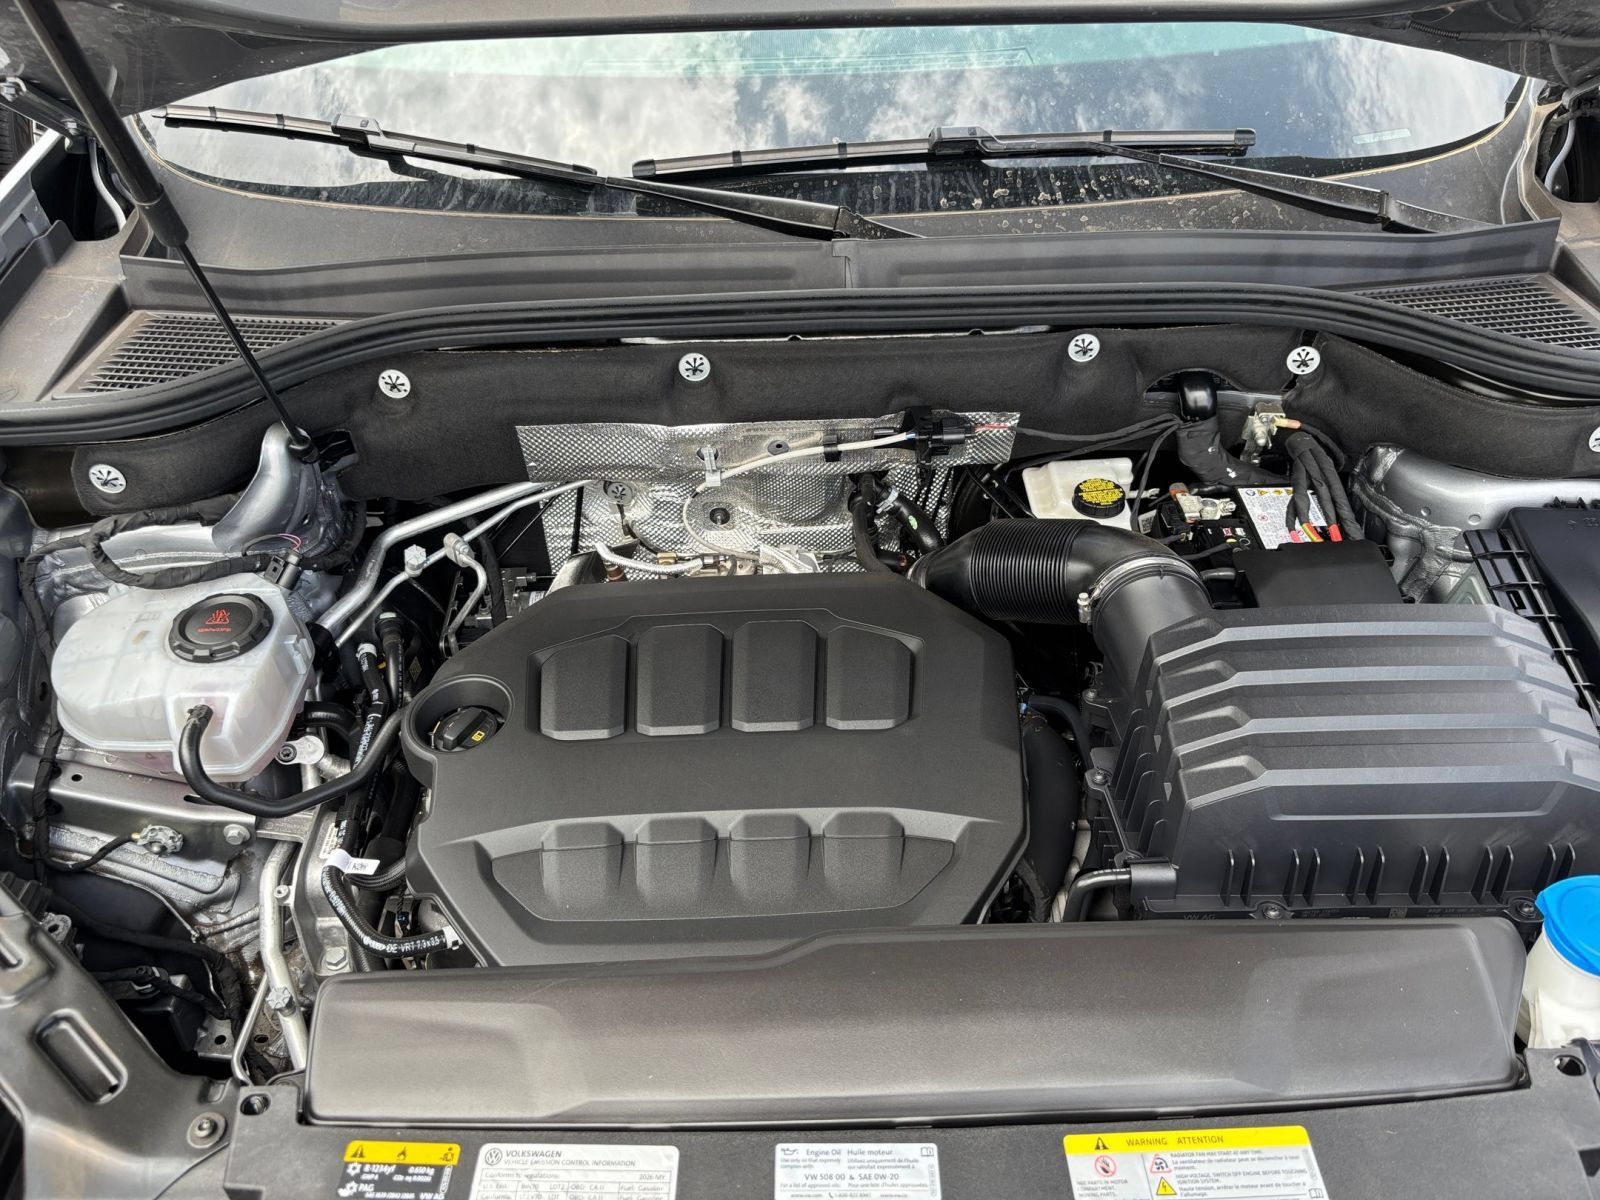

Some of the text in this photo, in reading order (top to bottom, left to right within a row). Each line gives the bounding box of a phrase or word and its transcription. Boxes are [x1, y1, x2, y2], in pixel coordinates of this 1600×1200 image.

[1126, 1135, 1224, 1147] WARNING ATTENTION
[506, 1149, 562, 1158] VOLKSWAGEN
[806, 1148, 841, 1157] Engine Oil
[359, 1183, 375, 1192] PAG
